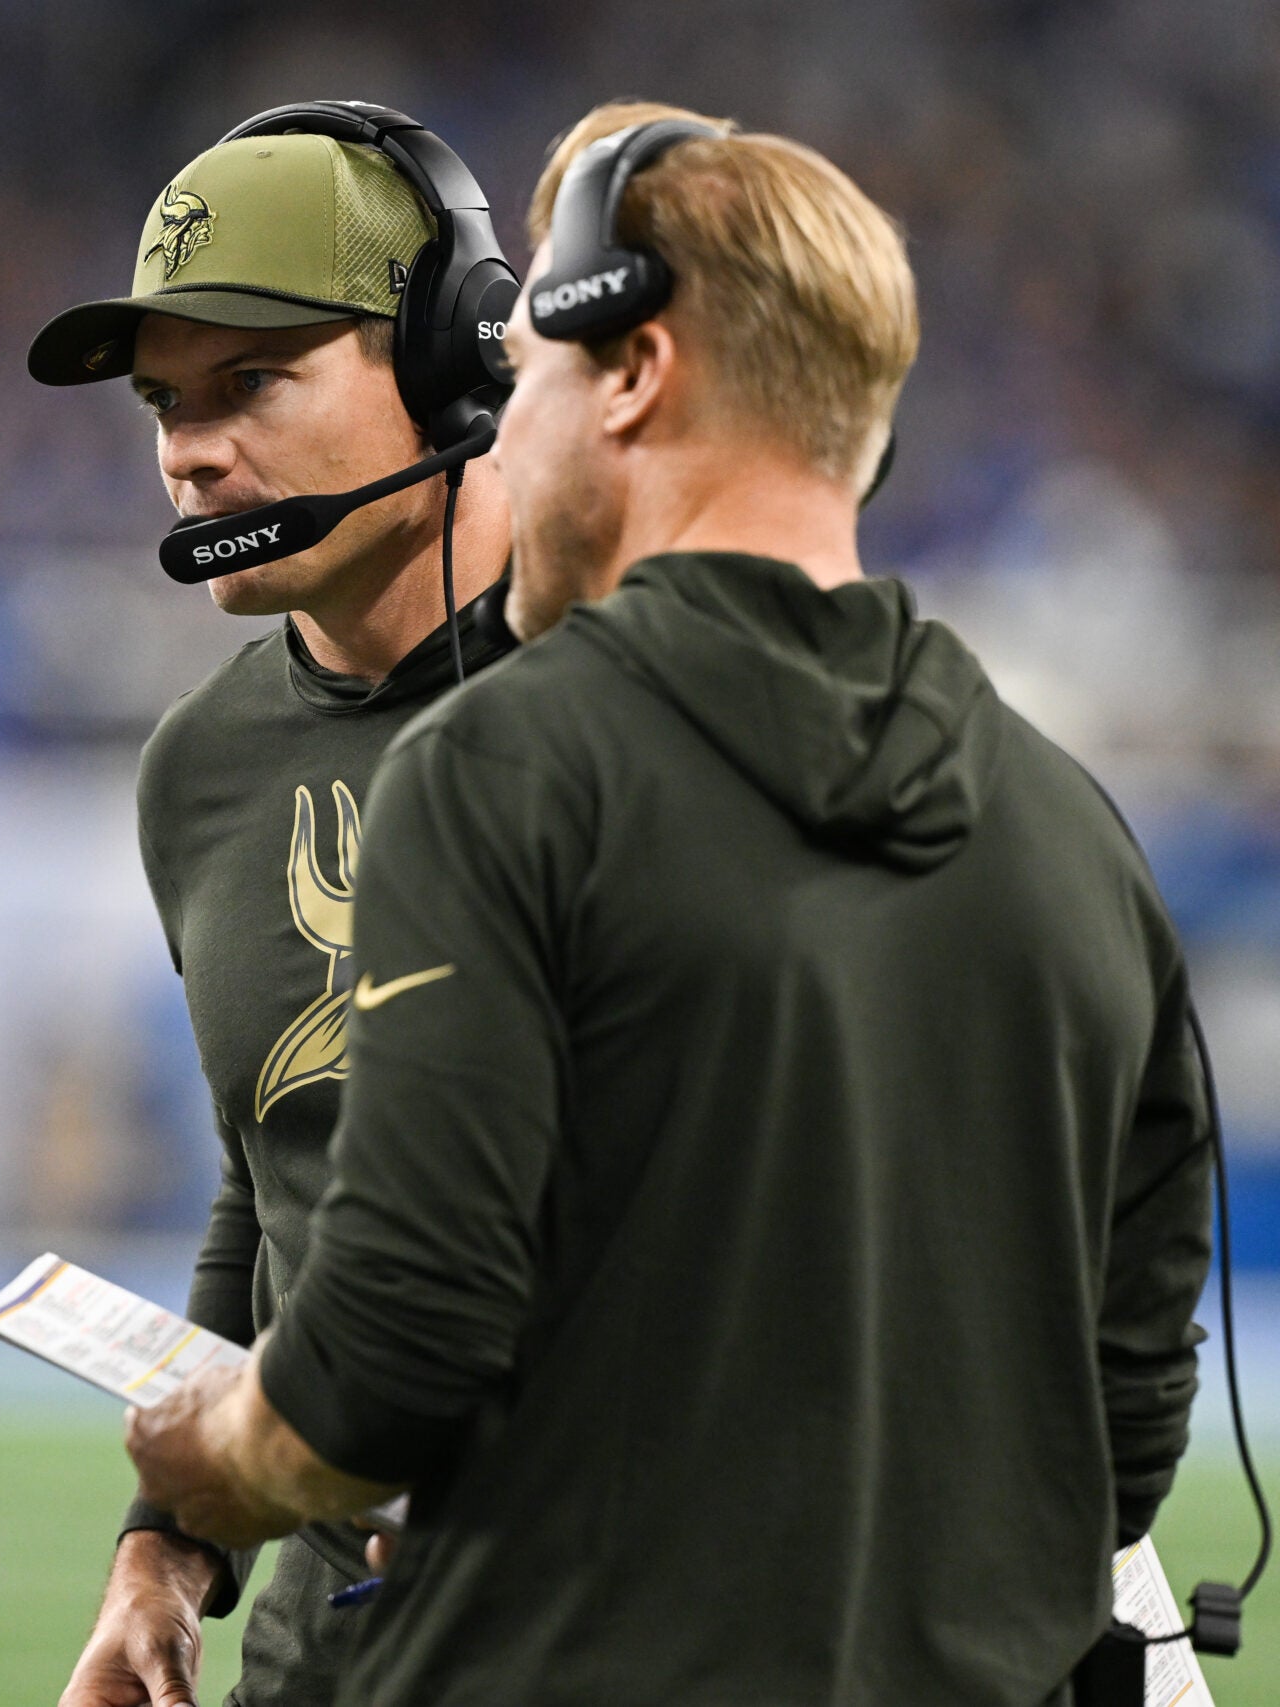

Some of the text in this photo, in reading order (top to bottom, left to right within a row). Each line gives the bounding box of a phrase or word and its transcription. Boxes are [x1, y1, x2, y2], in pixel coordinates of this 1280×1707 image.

[532, 267, 631, 319] SONY
[477, 321, 509, 340] SO
[192, 523, 281, 565] SONY
